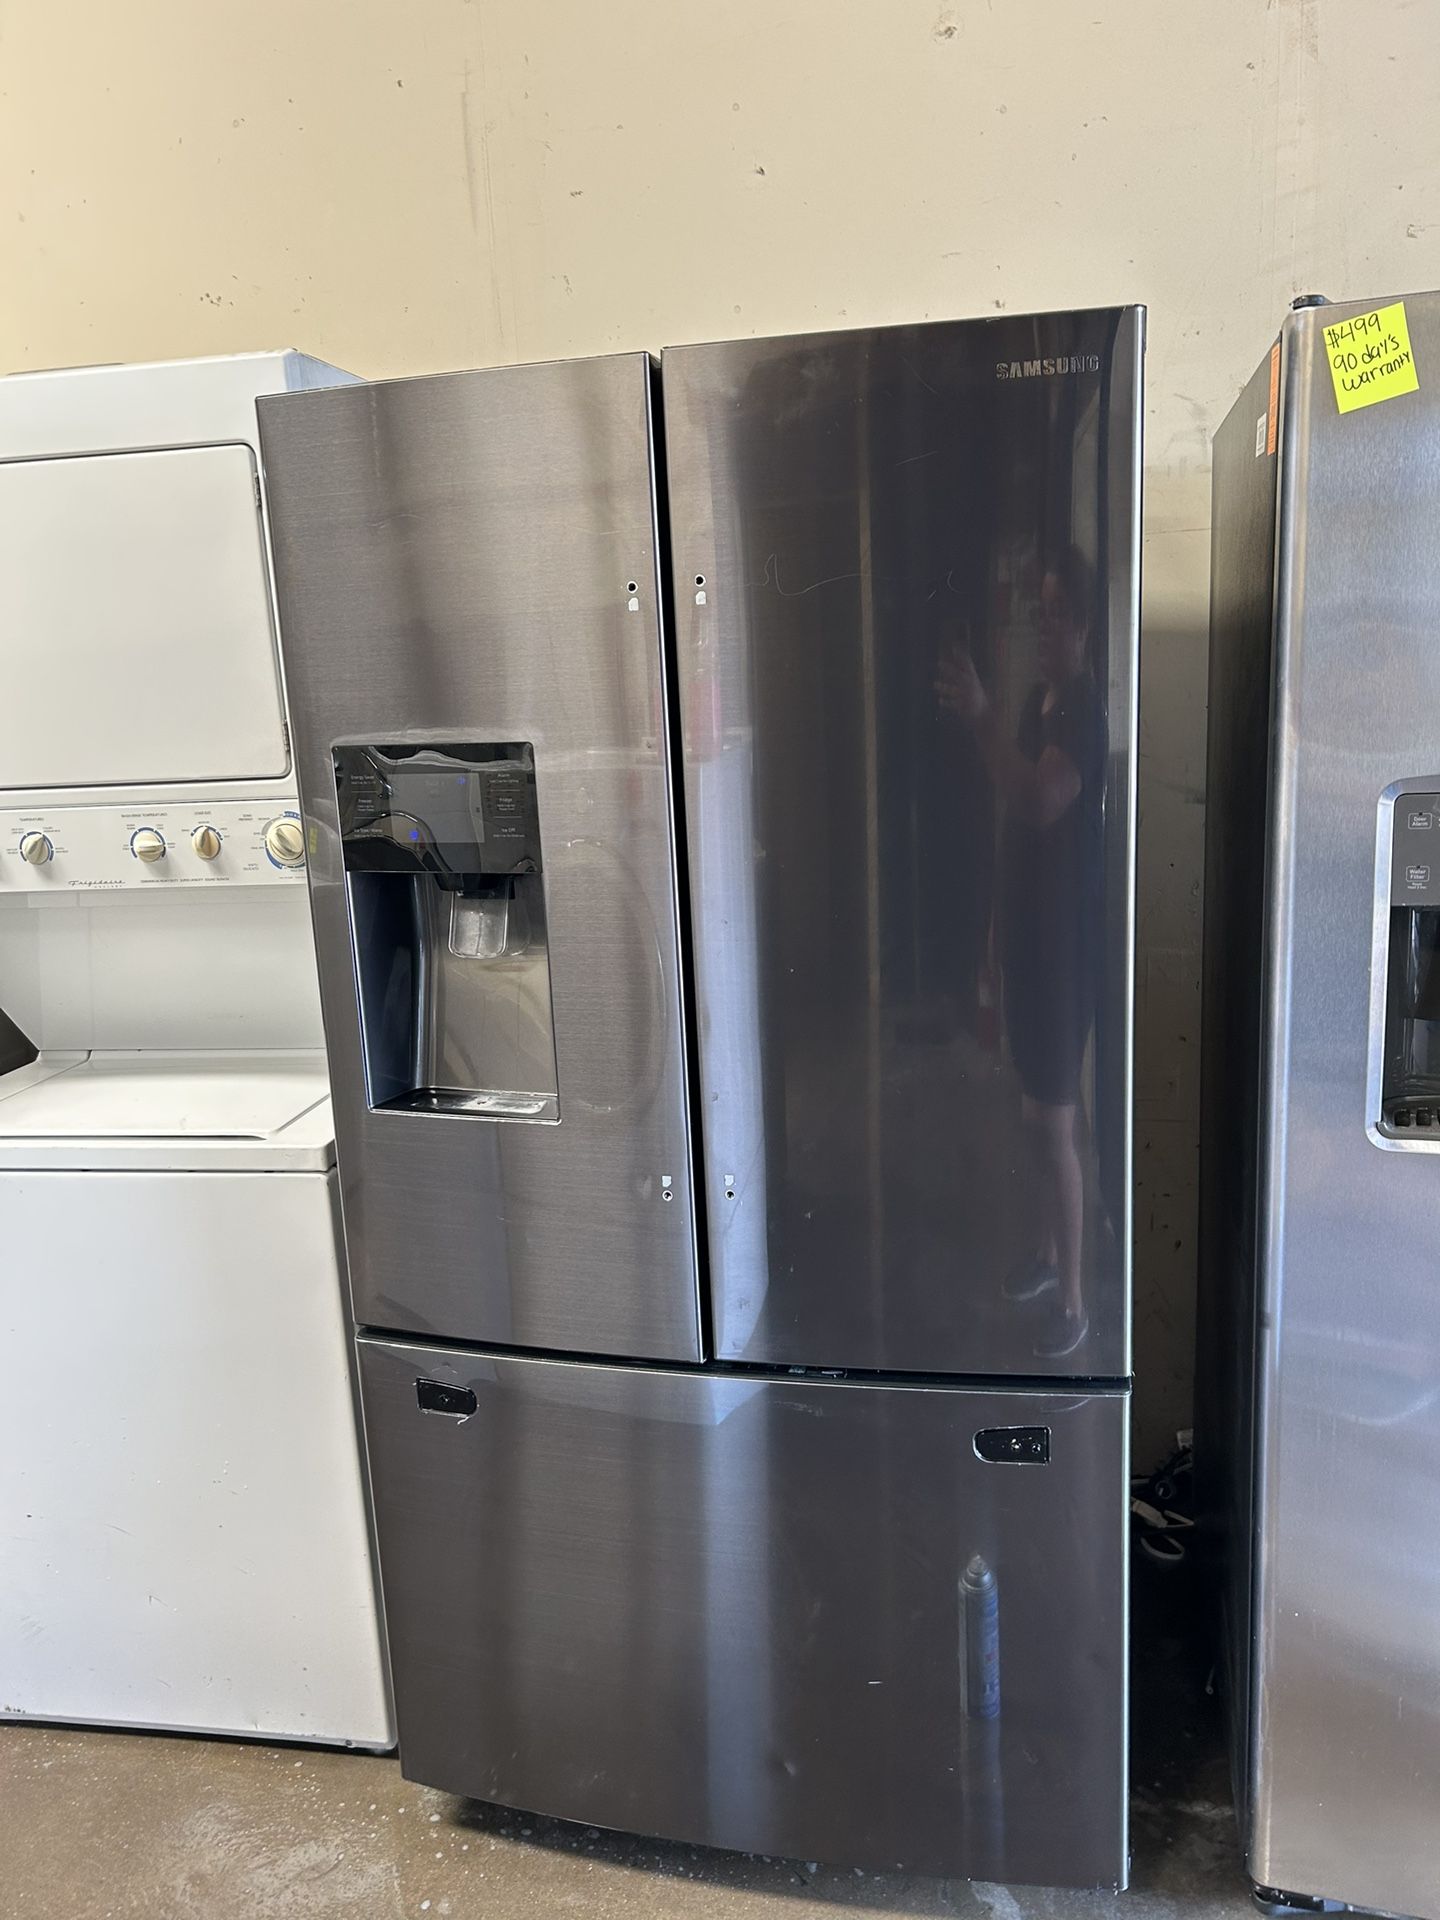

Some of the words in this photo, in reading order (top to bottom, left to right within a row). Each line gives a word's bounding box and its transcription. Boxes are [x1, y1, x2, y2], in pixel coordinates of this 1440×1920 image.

[1326, 313, 1381, 349] $499
[996, 355, 1099, 379] SAMSUNG
[1333, 352, 1358, 373] 90
[1341, 351, 1411, 391] warranty
